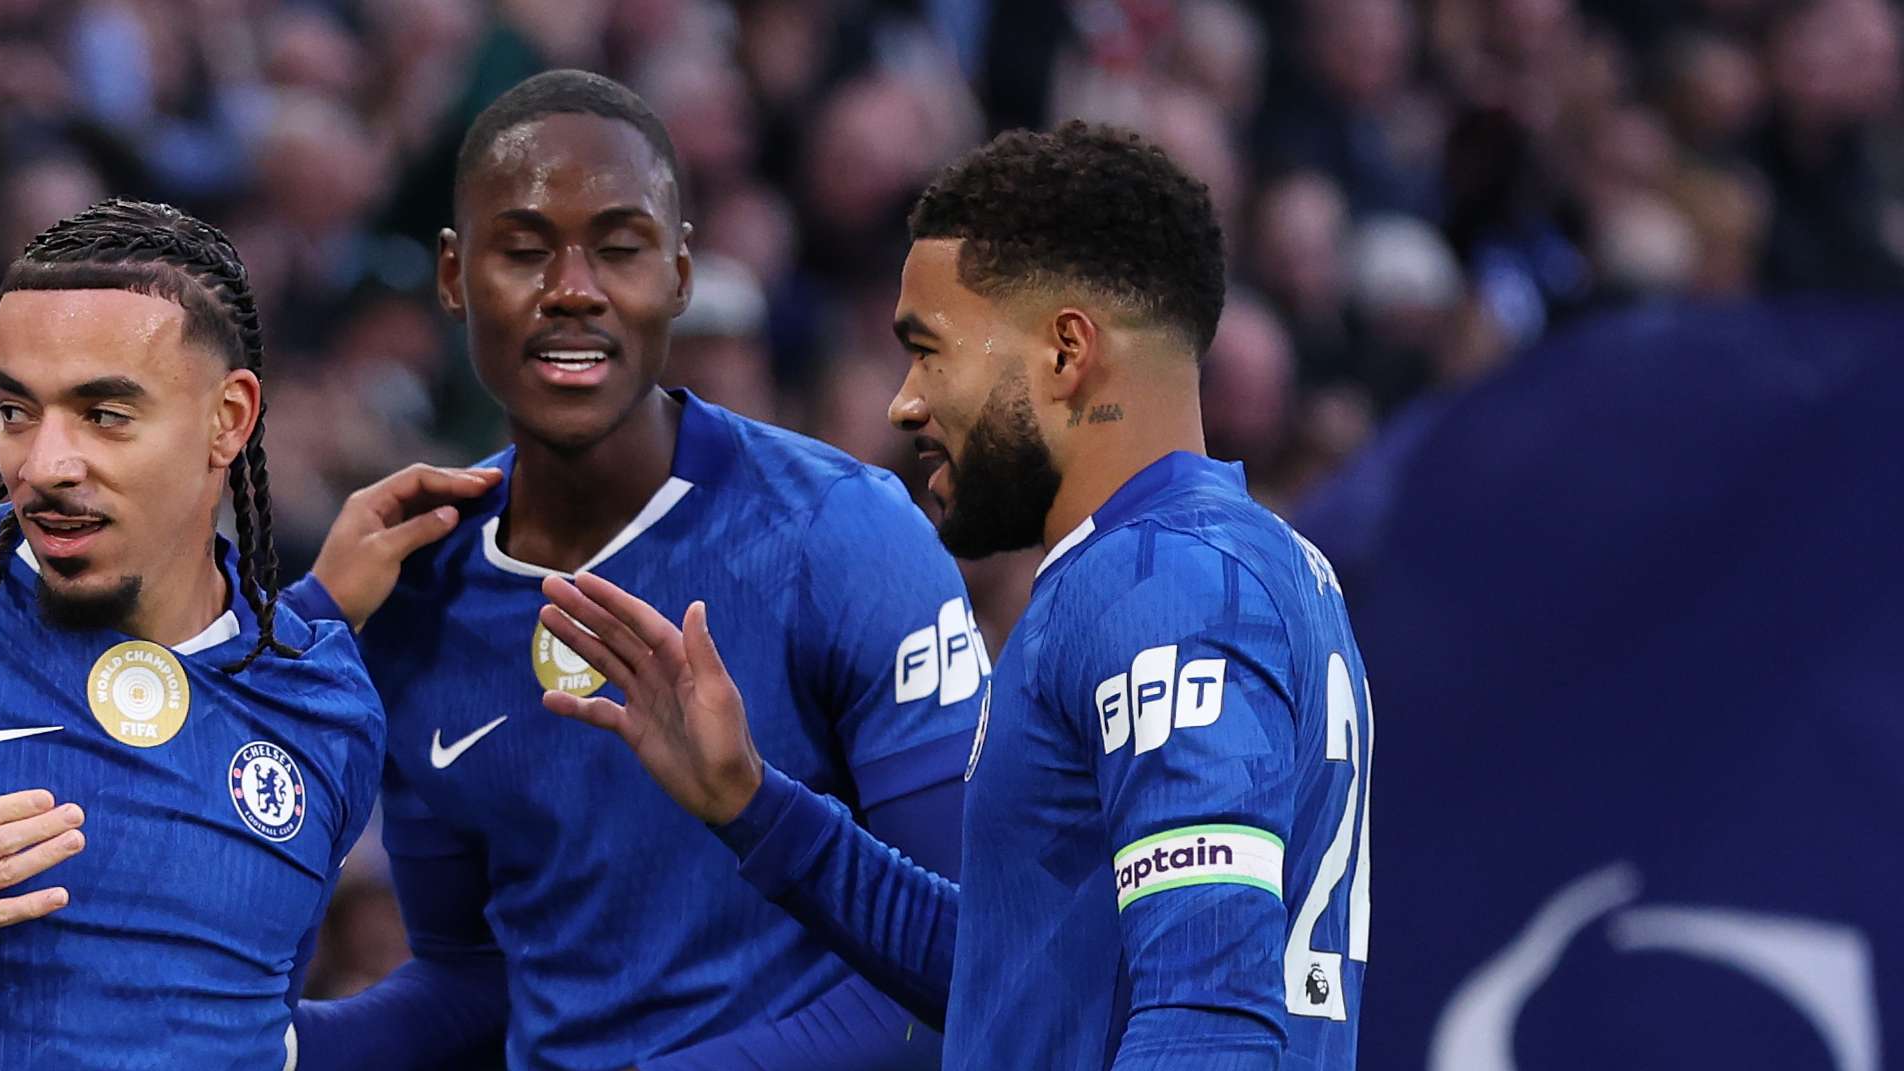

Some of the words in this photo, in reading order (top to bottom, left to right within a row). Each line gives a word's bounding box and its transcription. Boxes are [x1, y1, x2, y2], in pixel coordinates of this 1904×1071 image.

[97, 656, 123, 703] WORLD
[125, 650, 181, 710] CHAMPIONS
[899, 621, 986, 691] FP
[120, 721, 158, 738] FIFA
[1099, 669, 1220, 741] FPT
[242, 745, 292, 773] CHELSEA
[245, 810, 277, 836] FOOTBALL
[279, 822, 294, 835] CLUB
[1116, 837, 1233, 895] aptain
